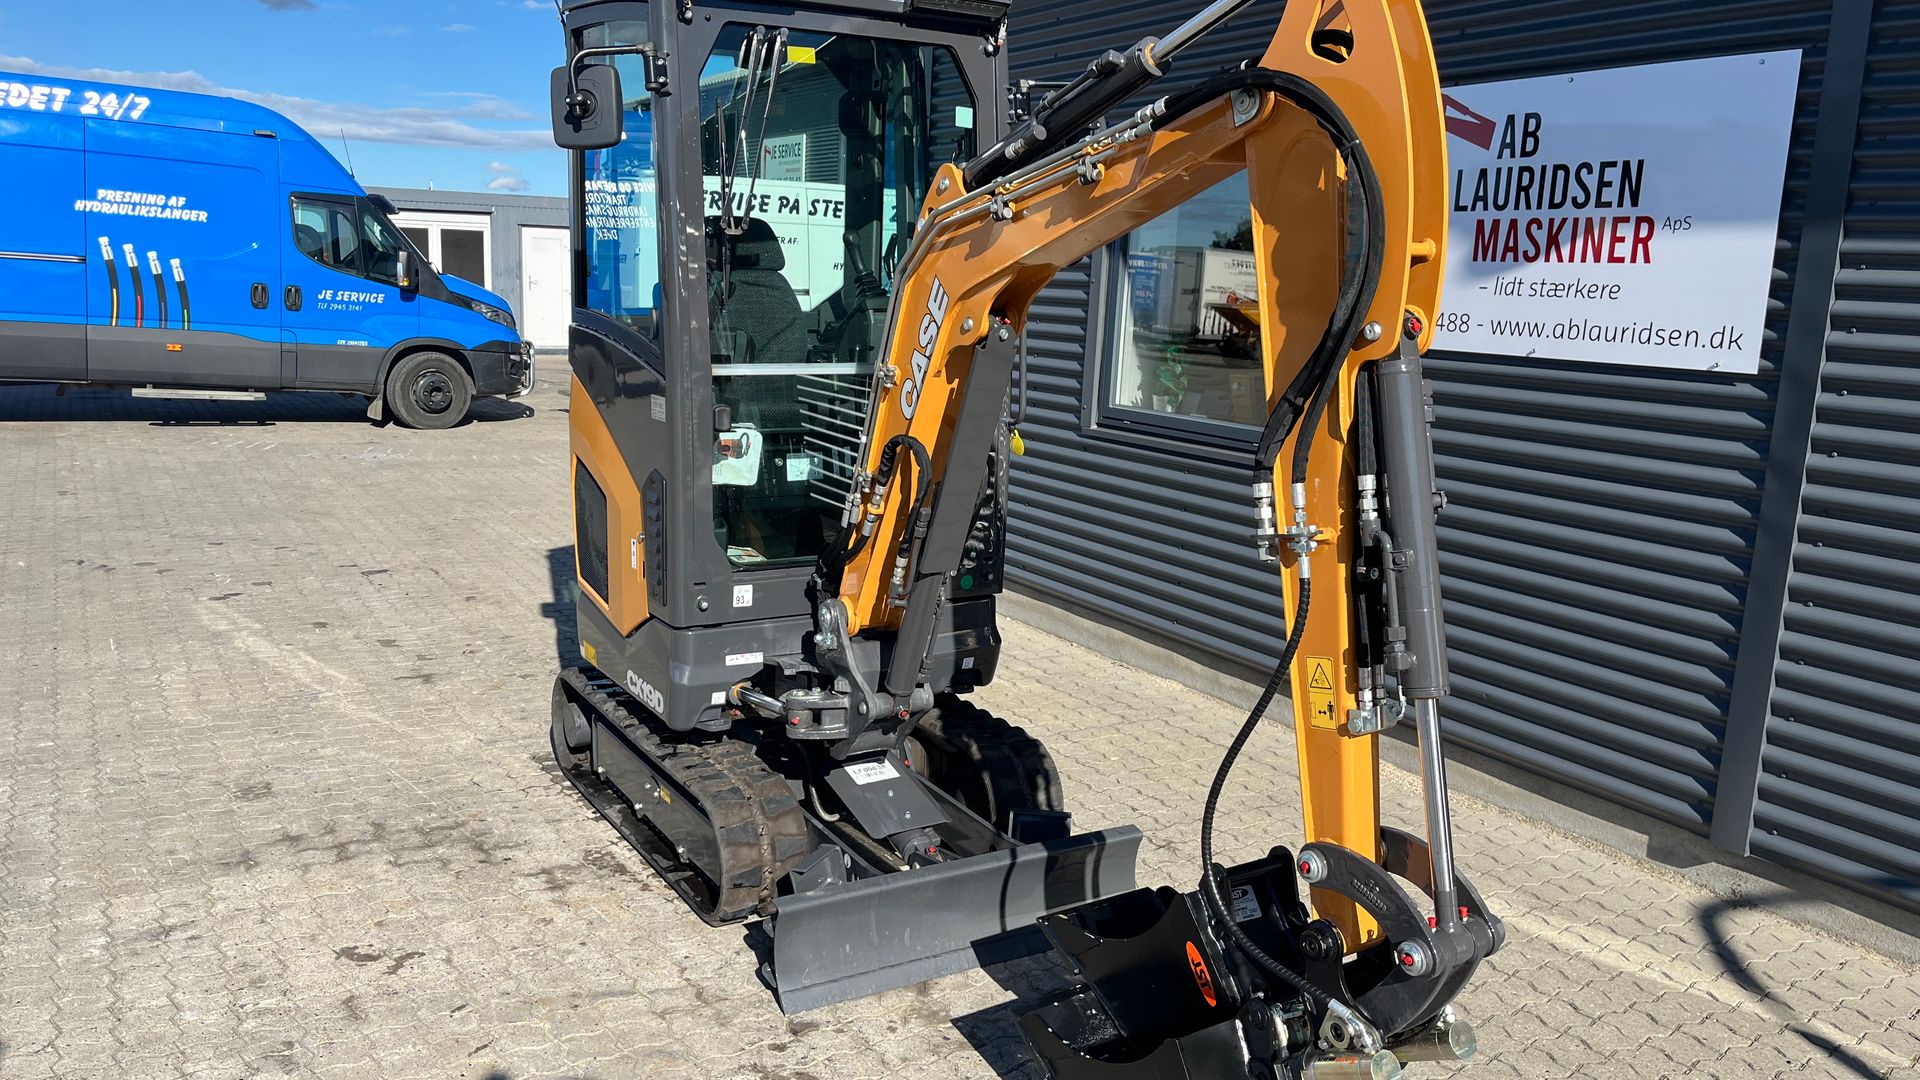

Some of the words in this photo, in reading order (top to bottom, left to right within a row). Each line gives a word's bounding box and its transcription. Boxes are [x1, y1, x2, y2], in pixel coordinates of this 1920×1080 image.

[80, 91, 150, 120] 24/7
[1497, 112, 1542, 159] AB
[778, 142, 801, 159] SERVICE
[97, 189, 165, 205] PRESNING
[168, 196, 186, 207] AF
[1454, 159, 1645, 212] LAURIDSEN
[75, 199, 208, 222] HYDRAULIKSLANGER
[1472, 216, 1655, 264] MASKINER
[1662, 216, 1692, 233] ApS
[317, 289, 334, 301] JE
[336, 291, 385, 304] SERVICE
[1494, 276, 1524, 297] lidt
[1528, 278, 1621, 300] stærkere
[317, 302, 328, 310] TLF
[329, 303, 346, 311] 2945
[347, 304, 363, 312] 3141
[901, 274, 949, 421] CASE
[1491, 318, 1744, 351] www.ablauridsen.dk
[735, 595, 745, 605] 93
[626, 669, 664, 714] CX19D
